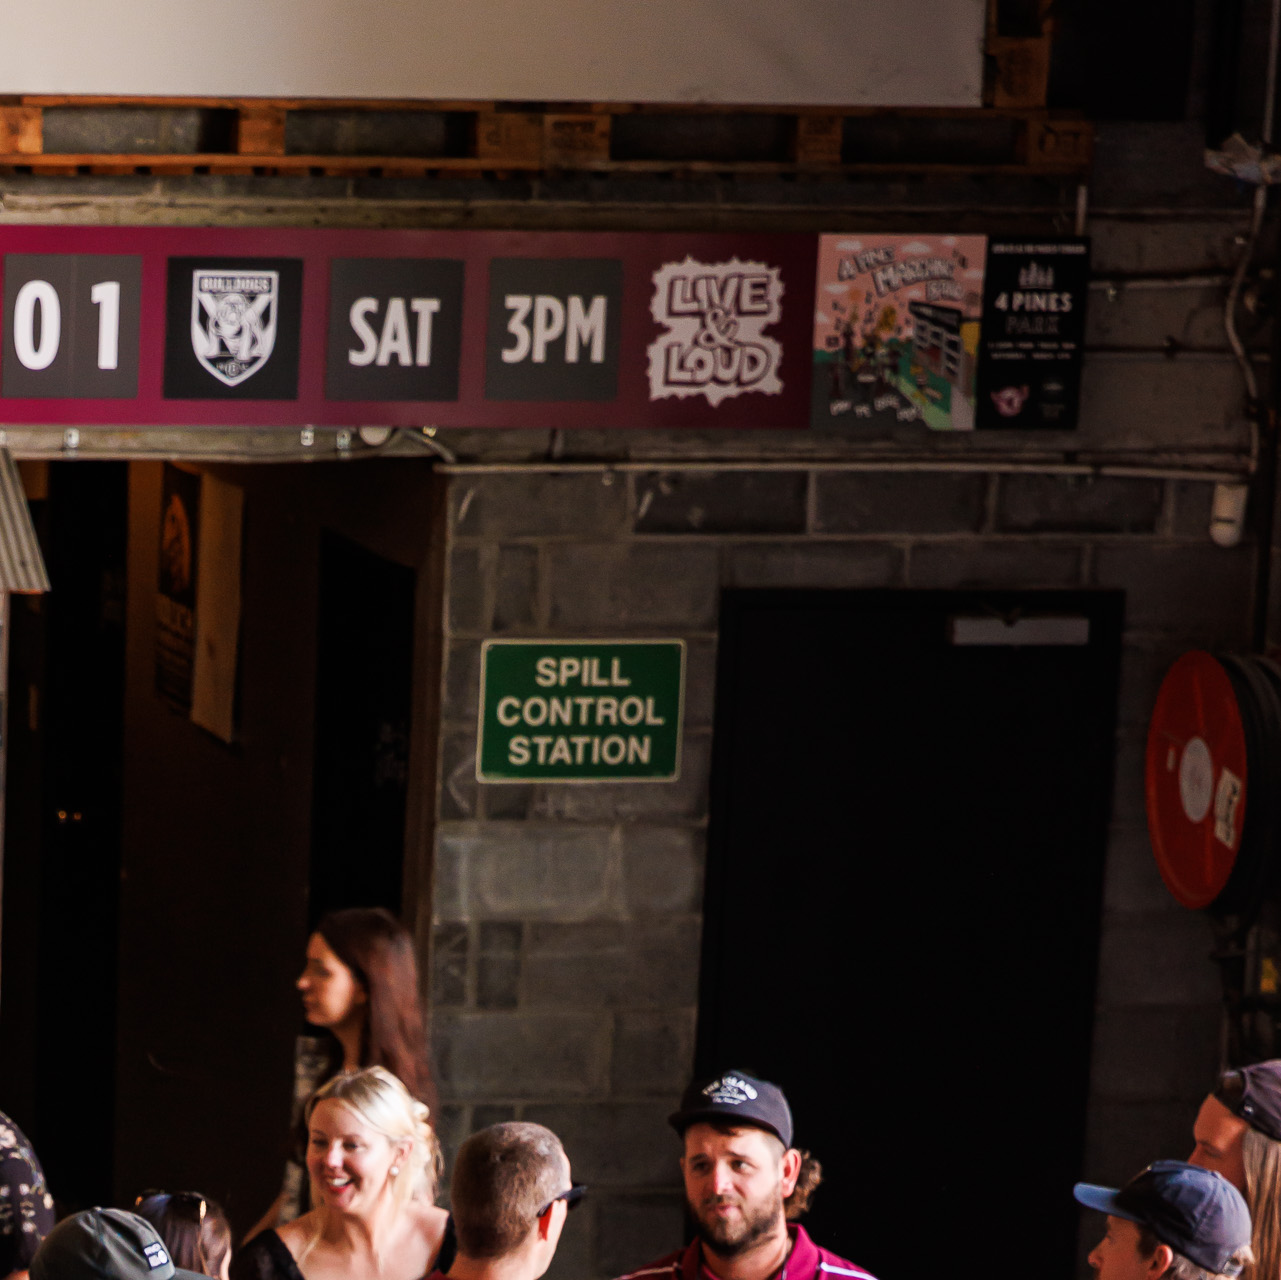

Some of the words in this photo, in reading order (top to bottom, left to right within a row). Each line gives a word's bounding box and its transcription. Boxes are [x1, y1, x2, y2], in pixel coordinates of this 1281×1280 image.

[668, 273, 770, 316] LIVE
[994, 292, 1009, 312] 4
[1012, 291, 1073, 313] PINES
[347, 297, 441, 366] SAT
[500, 294, 608, 364] 3PM
[698, 308, 740, 348] &
[663, 342, 771, 388] LOUD
[535, 657, 631, 687] SPILL
[496, 696, 665, 727] CONTROL
[507, 735, 651, 766] STATION
